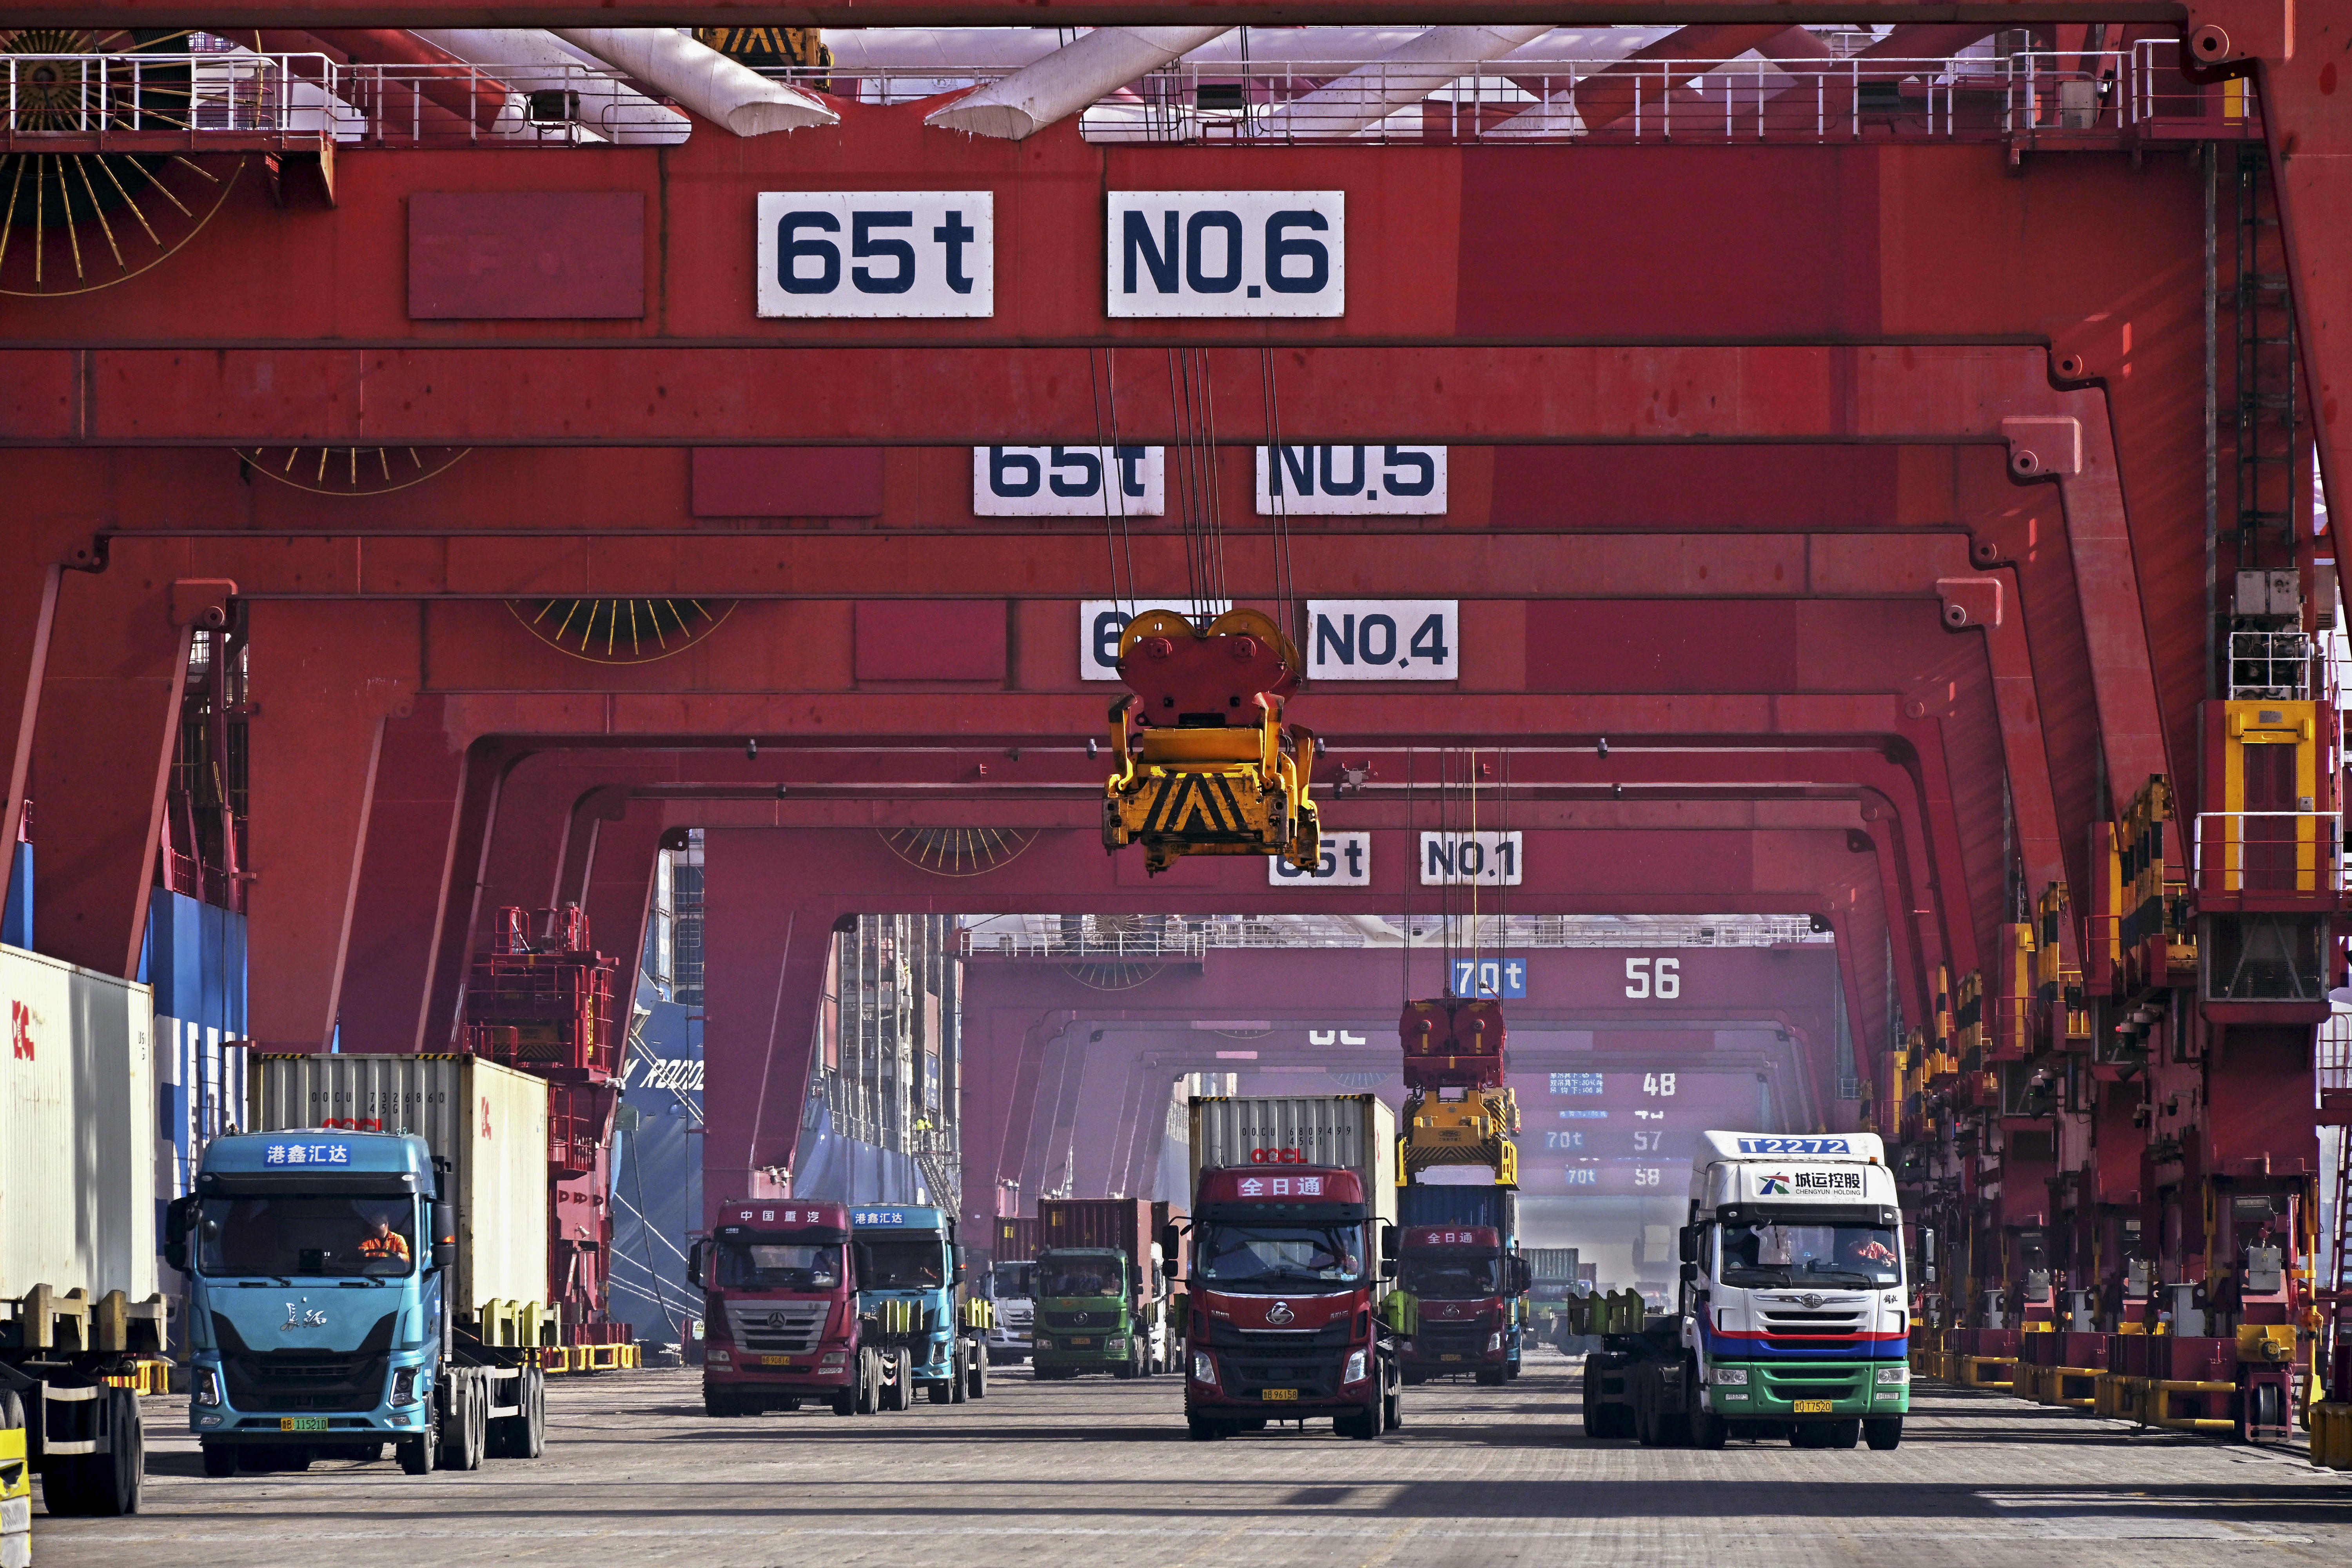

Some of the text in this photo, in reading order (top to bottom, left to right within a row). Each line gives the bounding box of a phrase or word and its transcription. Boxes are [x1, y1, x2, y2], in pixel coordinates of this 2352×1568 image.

[778, 211, 974, 294] 65t
[1123, 210, 1328, 298] NO.6
[1269, 446, 1434, 501] NO.5
[1317, 613, 1448, 668] NO.4
[1428, 841, 1514, 877] NO.1
[1456, 962, 1522, 994] 70t
[1626, 957, 1679, 999] 56
[1643, 1073, 1675, 1096] 48
[369, 1104, 410, 1114] 45G1
[1289, 1137, 1322, 1145] 45G1
[1547, 1132, 1582, 1148] 70t
[1634, 1131, 1662, 1151] 57
[1740, 1139, 1847, 1153] T2272
[267, 1144, 347, 1163] 港鑫汇达
[1250, 1148, 1308, 1163] OOCL
[1568, 1169, 1595, 1184] 70t
[1635, 1168, 1660, 1187] 58
[1795, 1172, 1860, 1189] 城运控股
[1241, 1177, 1321, 1196] 全日通
[740, 1210, 819, 1223] 中国重汽
[855, 1212, 902, 1224] 港鑫汇达
[1428, 1232, 1472, 1244] 全日通
